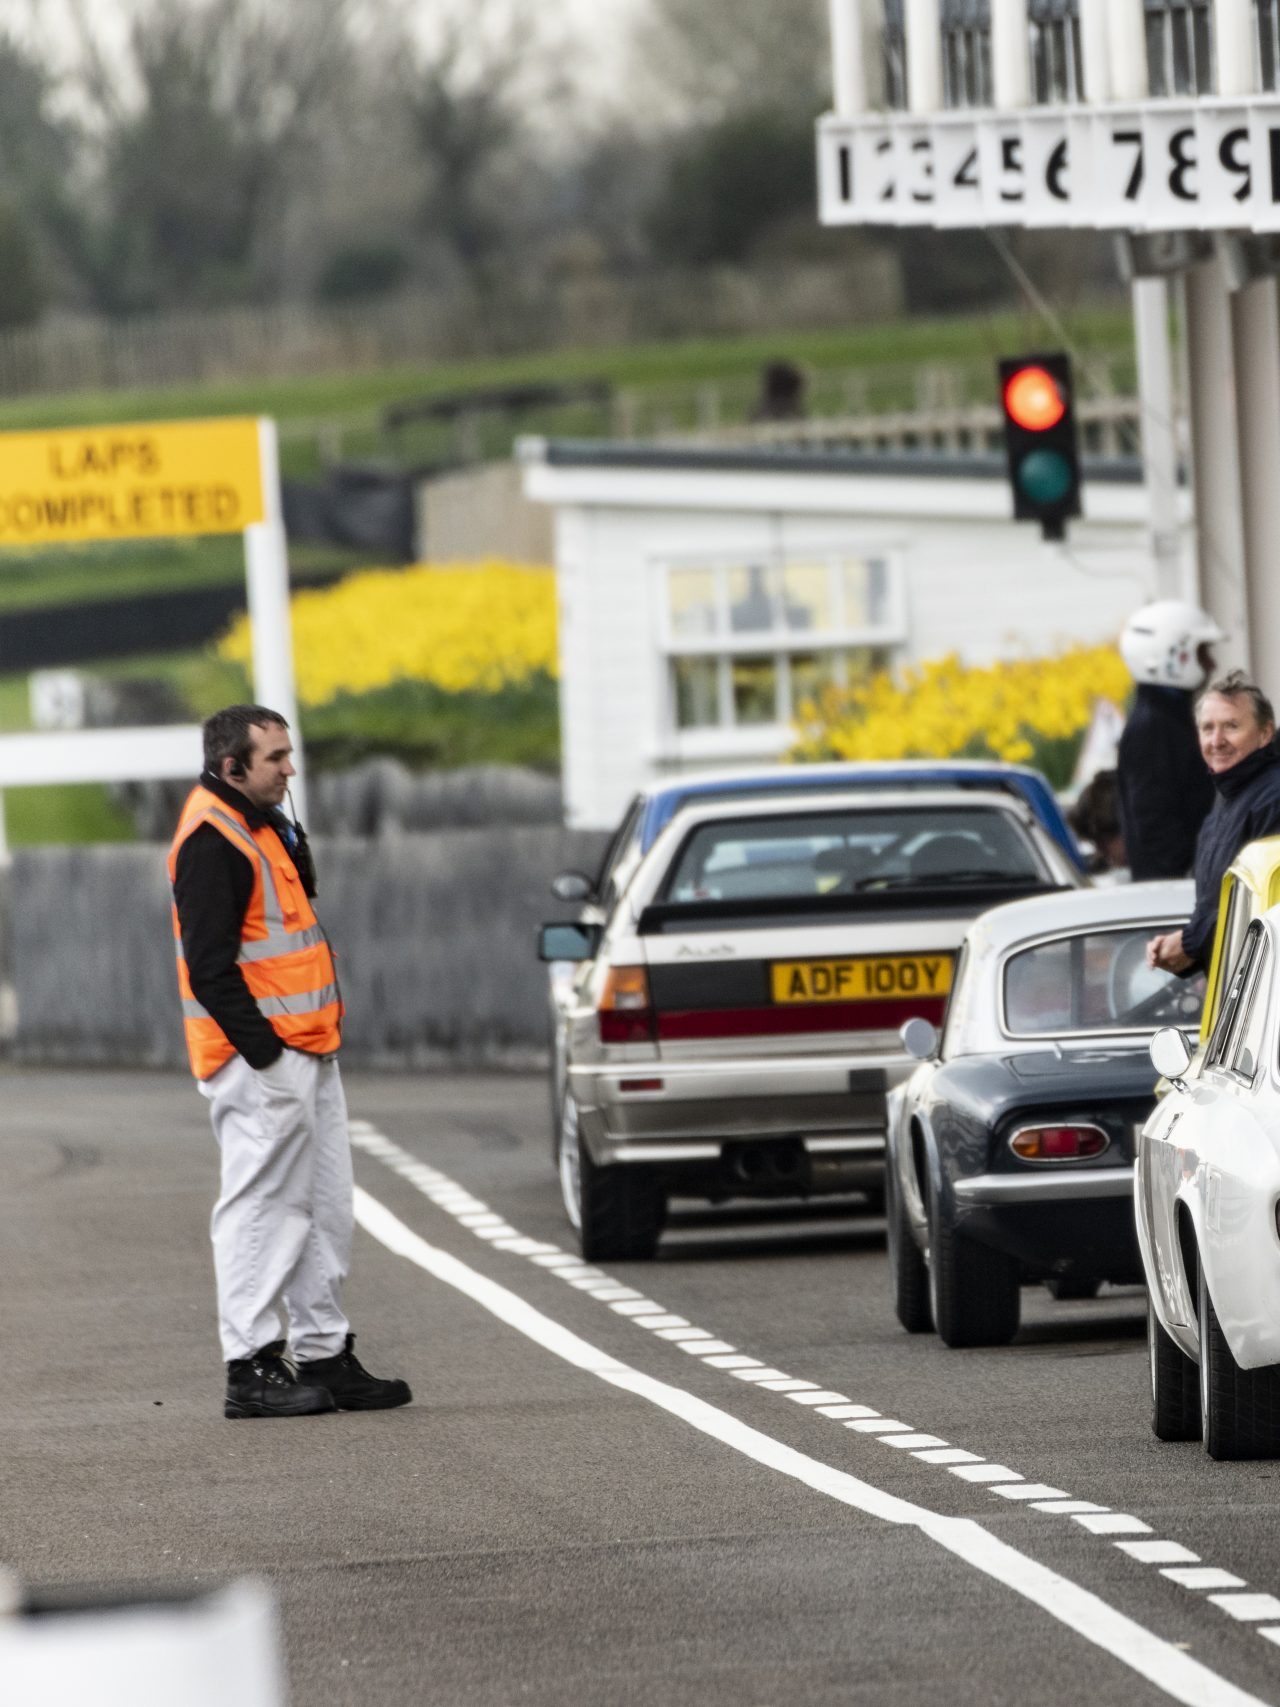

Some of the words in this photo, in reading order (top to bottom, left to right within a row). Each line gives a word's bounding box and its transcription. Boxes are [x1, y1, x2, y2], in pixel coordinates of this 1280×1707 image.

[1112, 130, 1144, 201] 7
[50, 438, 159, 479] LAPS
[789, 966, 854, 997] ADF
[865, 961, 941, 994] 100Y
